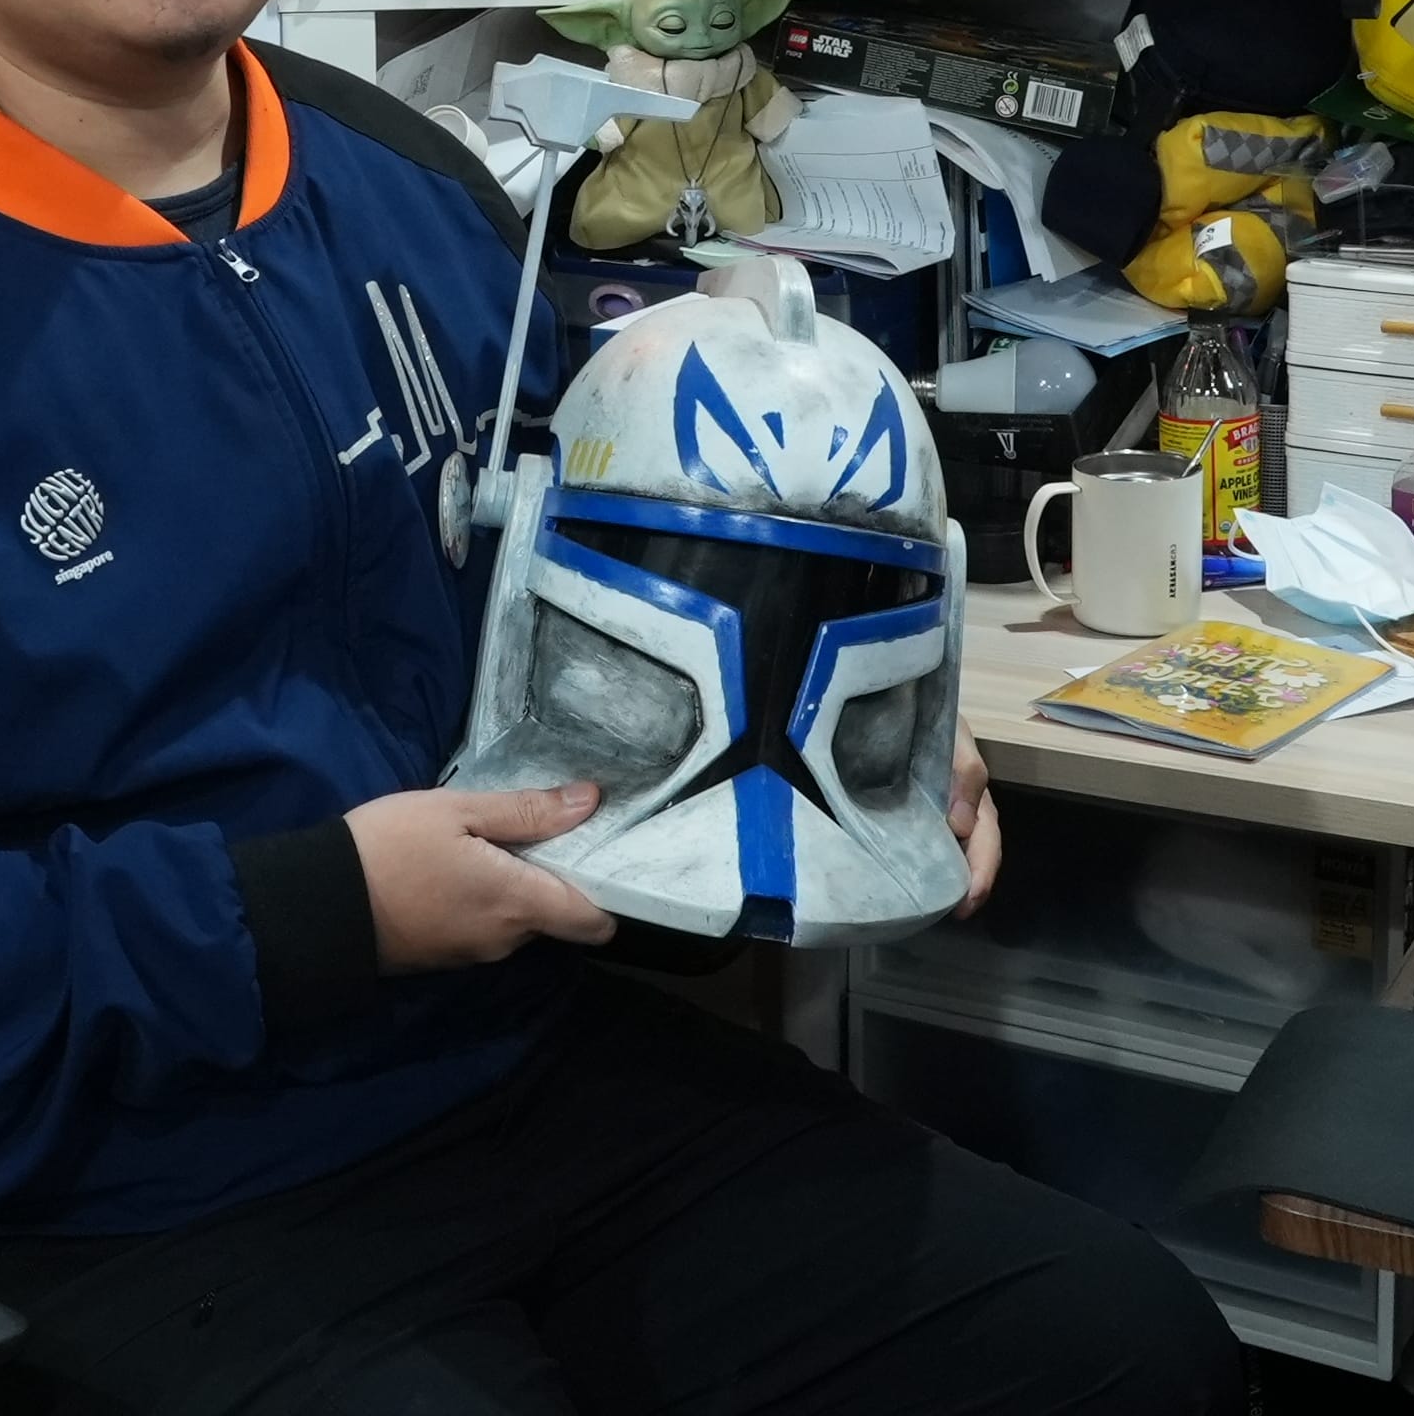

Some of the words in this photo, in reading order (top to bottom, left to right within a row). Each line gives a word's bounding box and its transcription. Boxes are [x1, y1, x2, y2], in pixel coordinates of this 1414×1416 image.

[789, 33, 809, 44] LEGO
[813, 34, 853, 51] STAR
[812, 42, 854, 59] WARS
[1220, 473, 1252, 490] APPLE
[21, 469, 91, 544] SCIENCE
[39, 485, 105, 561] CENTRE
[55, 550, 114, 585] singapore
